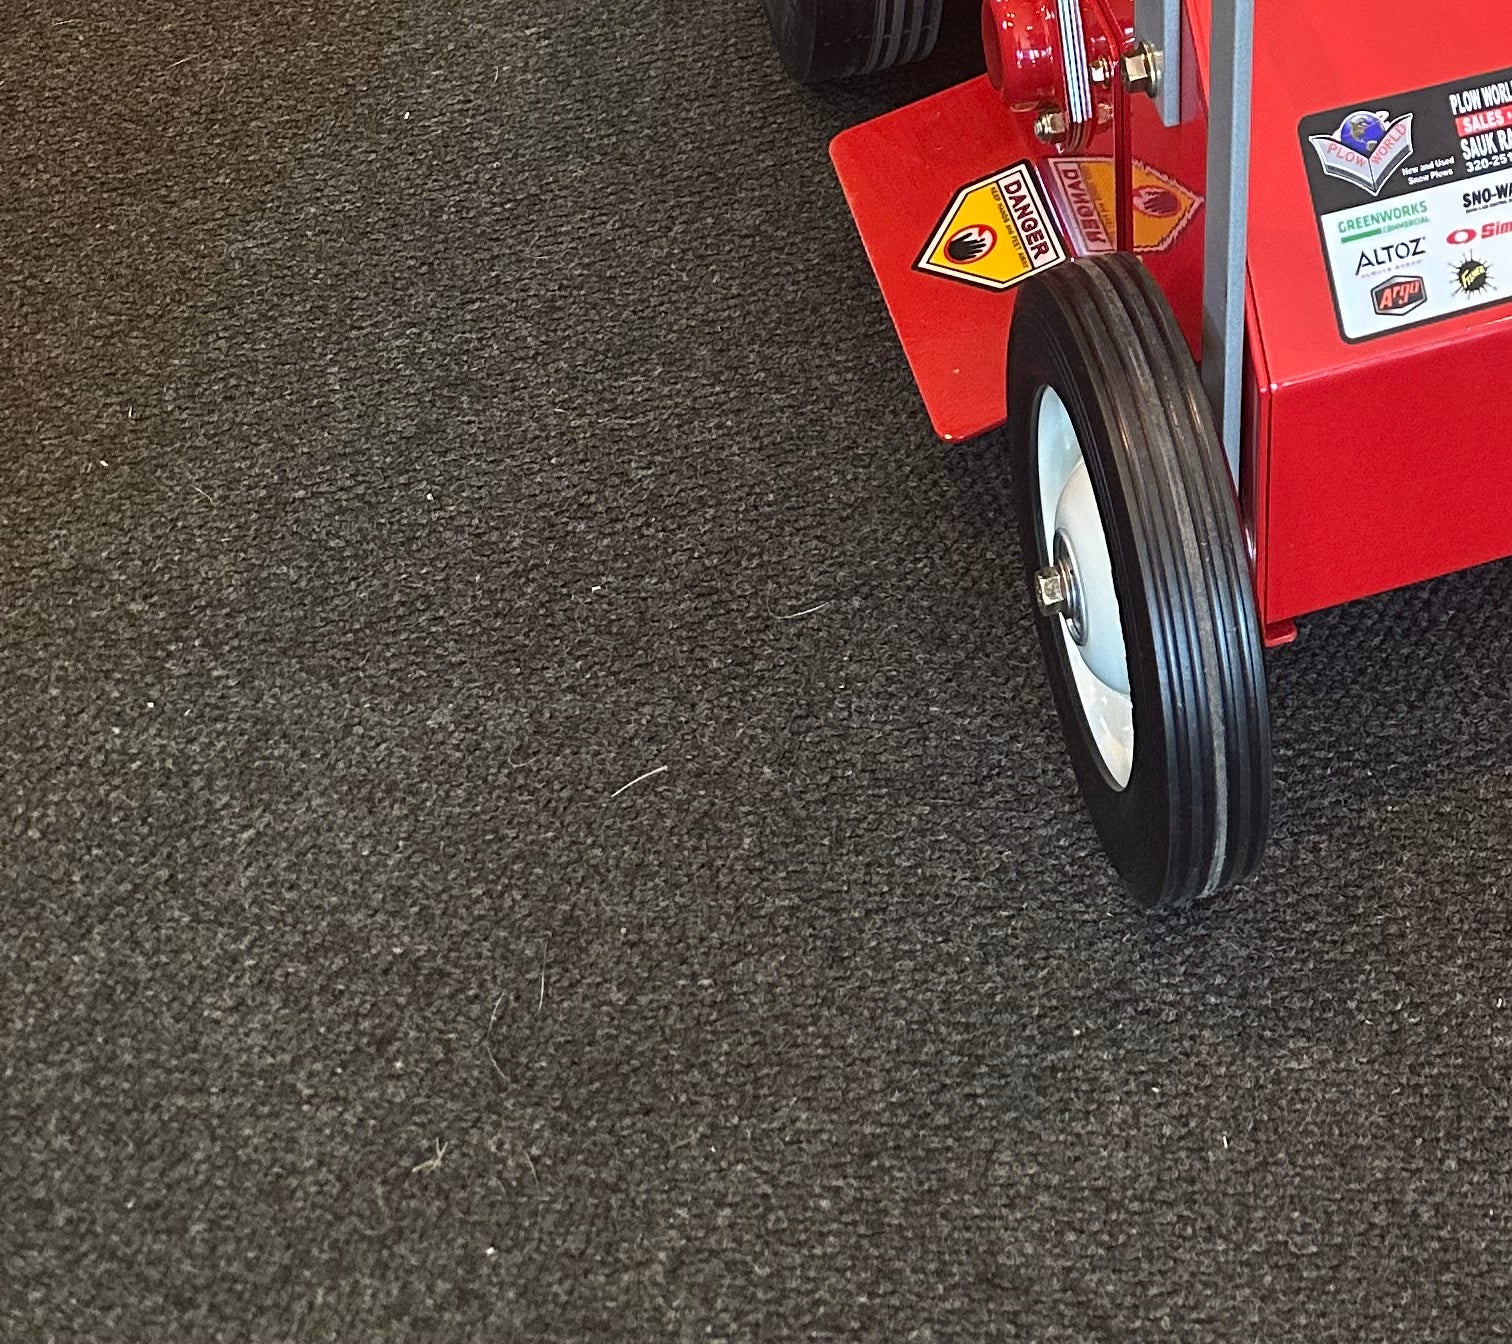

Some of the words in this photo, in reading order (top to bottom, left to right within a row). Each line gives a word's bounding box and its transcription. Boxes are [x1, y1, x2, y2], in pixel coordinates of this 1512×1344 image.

[1449, 91, 1482, 115] PLOW
[1462, 109, 1505, 133] SALES
[1327, 142, 1367, 168] PLOW
[1370, 121, 1408, 165] WORLD
[1460, 134, 1498, 160] SAUK
[1003, 179, 1050, 260] DANGER
[1338, 200, 1428, 233] GREENWORKS
[1355, 238, 1426, 276] ALTOZ
